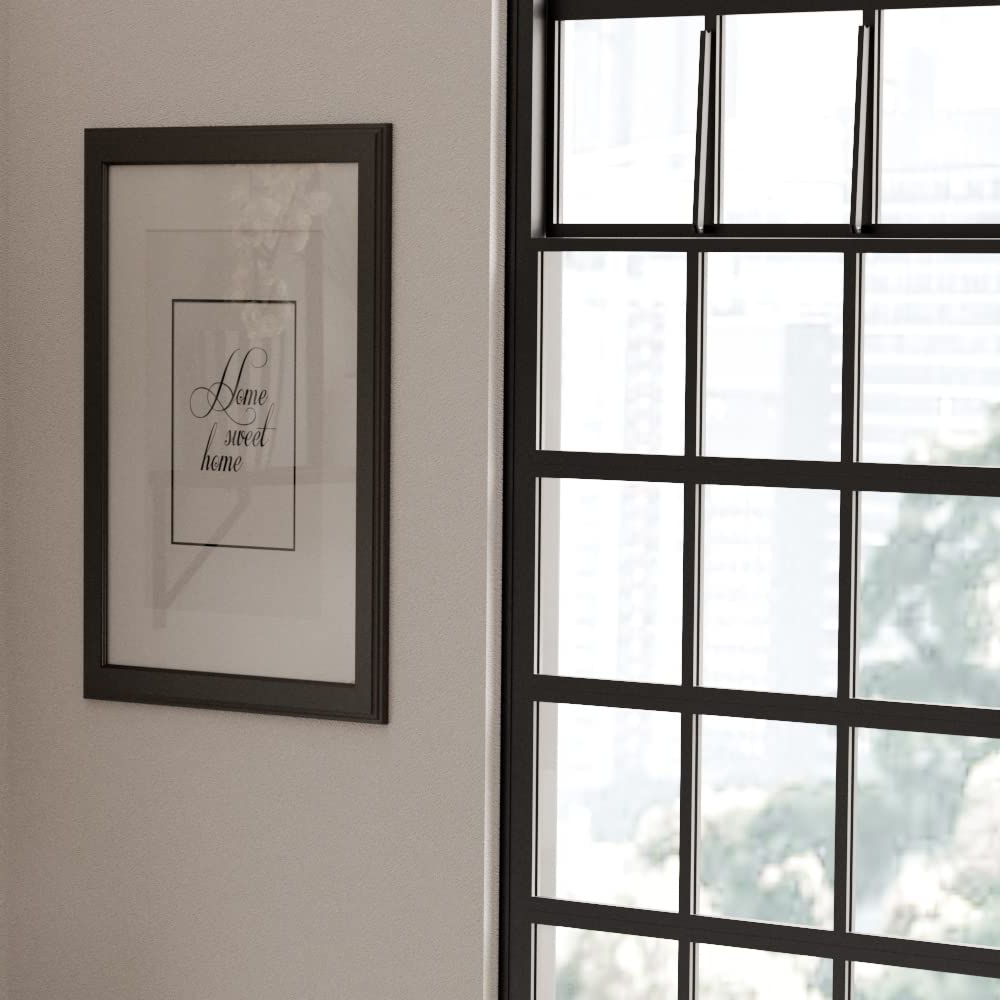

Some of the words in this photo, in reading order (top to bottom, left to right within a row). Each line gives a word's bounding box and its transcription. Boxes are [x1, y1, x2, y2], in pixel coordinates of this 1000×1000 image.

[190, 347, 269, 426] Home
[200, 422, 243, 472] home
[224, 403, 277, 447] sweet
